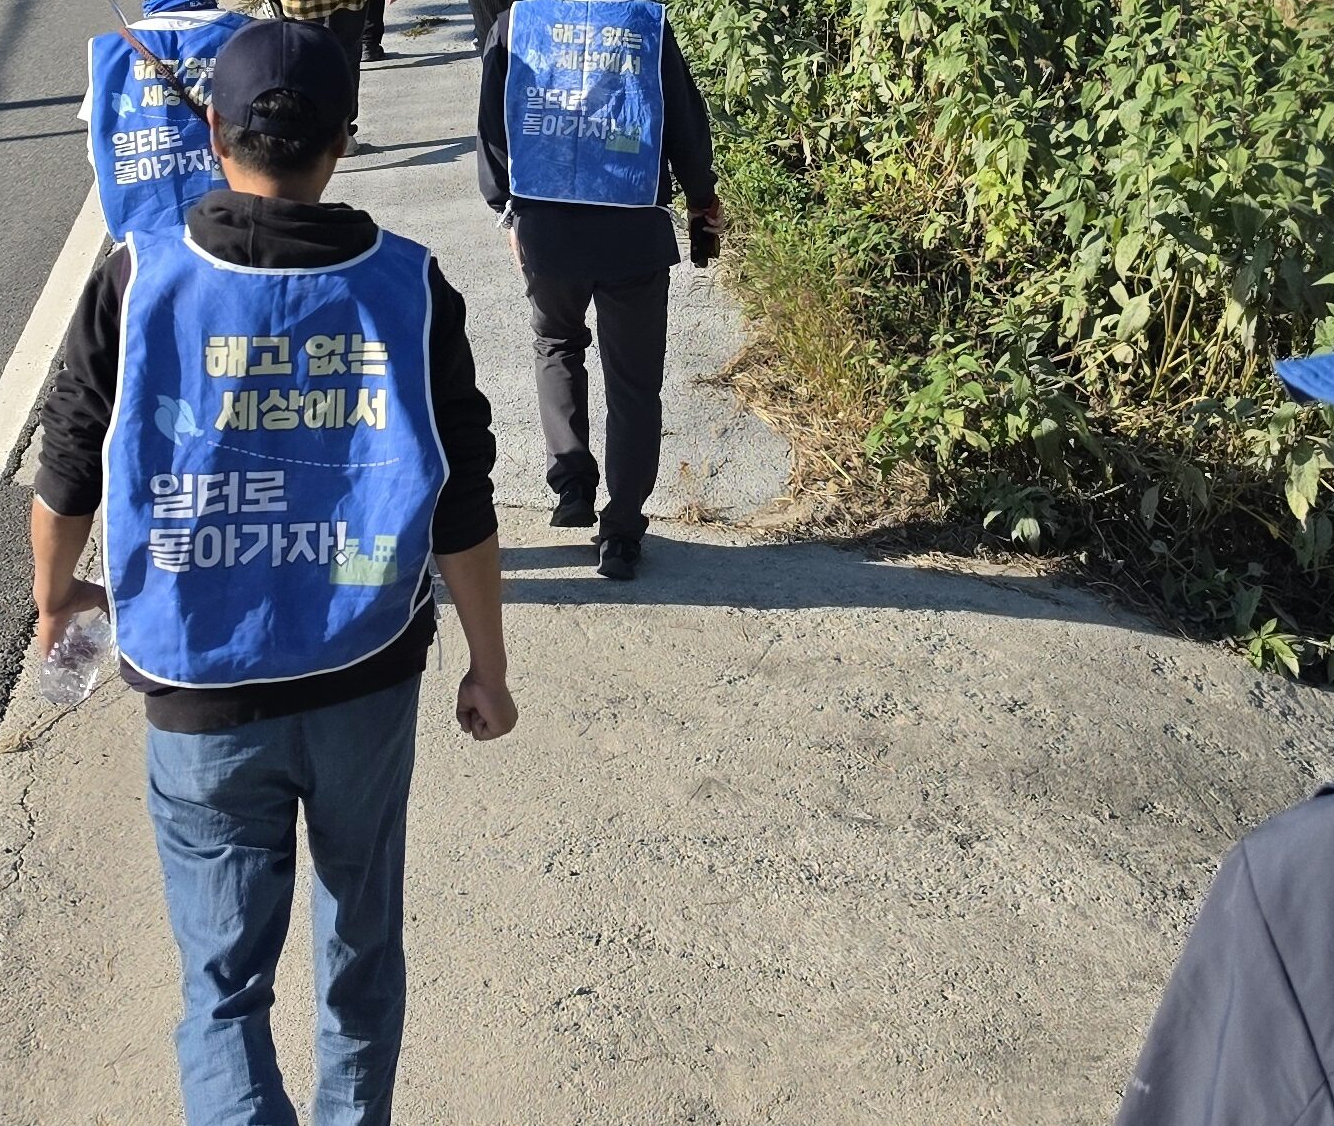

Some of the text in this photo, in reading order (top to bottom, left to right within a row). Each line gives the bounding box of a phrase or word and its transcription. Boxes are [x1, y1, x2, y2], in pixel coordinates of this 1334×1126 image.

[552, 24, 643, 50] 해고 없는
[555, 49, 642, 75] 세상에서
[525, 85, 588, 116] 일터로
[111, 126, 183, 158] 일터로
[522, 112, 618, 141] 돌아가자!
[204, 334, 389, 378] 해고 없는
[214, 388, 388, 431] 세상에서
[149, 470, 289, 519] 일터로
[147, 521, 349, 574] 돌아가자!
